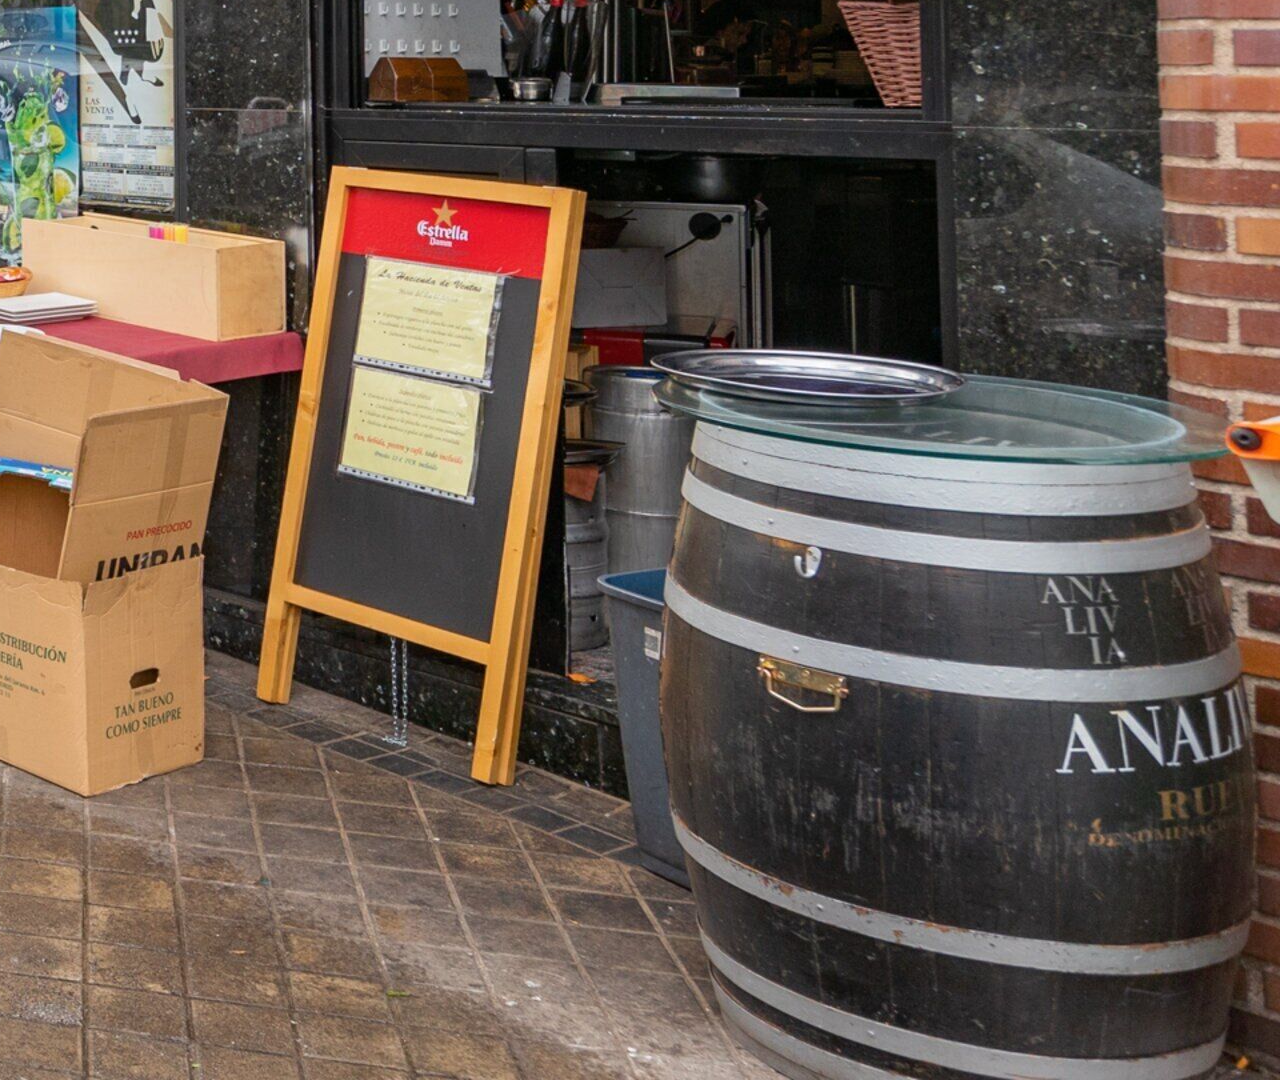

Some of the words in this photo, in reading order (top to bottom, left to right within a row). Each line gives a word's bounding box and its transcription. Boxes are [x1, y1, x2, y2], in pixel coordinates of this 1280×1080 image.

[85, 97, 100, 105] LAS
[85, 106, 114, 114] VENTAS
[416, 219, 469, 242] Estrella
[429, 236, 453, 248] Damm
[395, 271, 437, 286] Hacienda
[439, 277, 450, 287] de
[453, 280, 482, 293] Ventas
[126, 529, 145, 541] PAN
[145, 520, 193, 538] PRECOCIDO
[1040, 576, 1120, 605] ANA
[1062, 604, 1121, 636] LIV
[1088, 635, 1128, 665] IA
[114, 704, 136, 719] TAN
[139, 692, 174, 712] BUENO
[105, 720, 140, 740] COMO
[142, 707, 182, 730] SIEMPRE
[1055, 685, 1250, 774] ANALI
